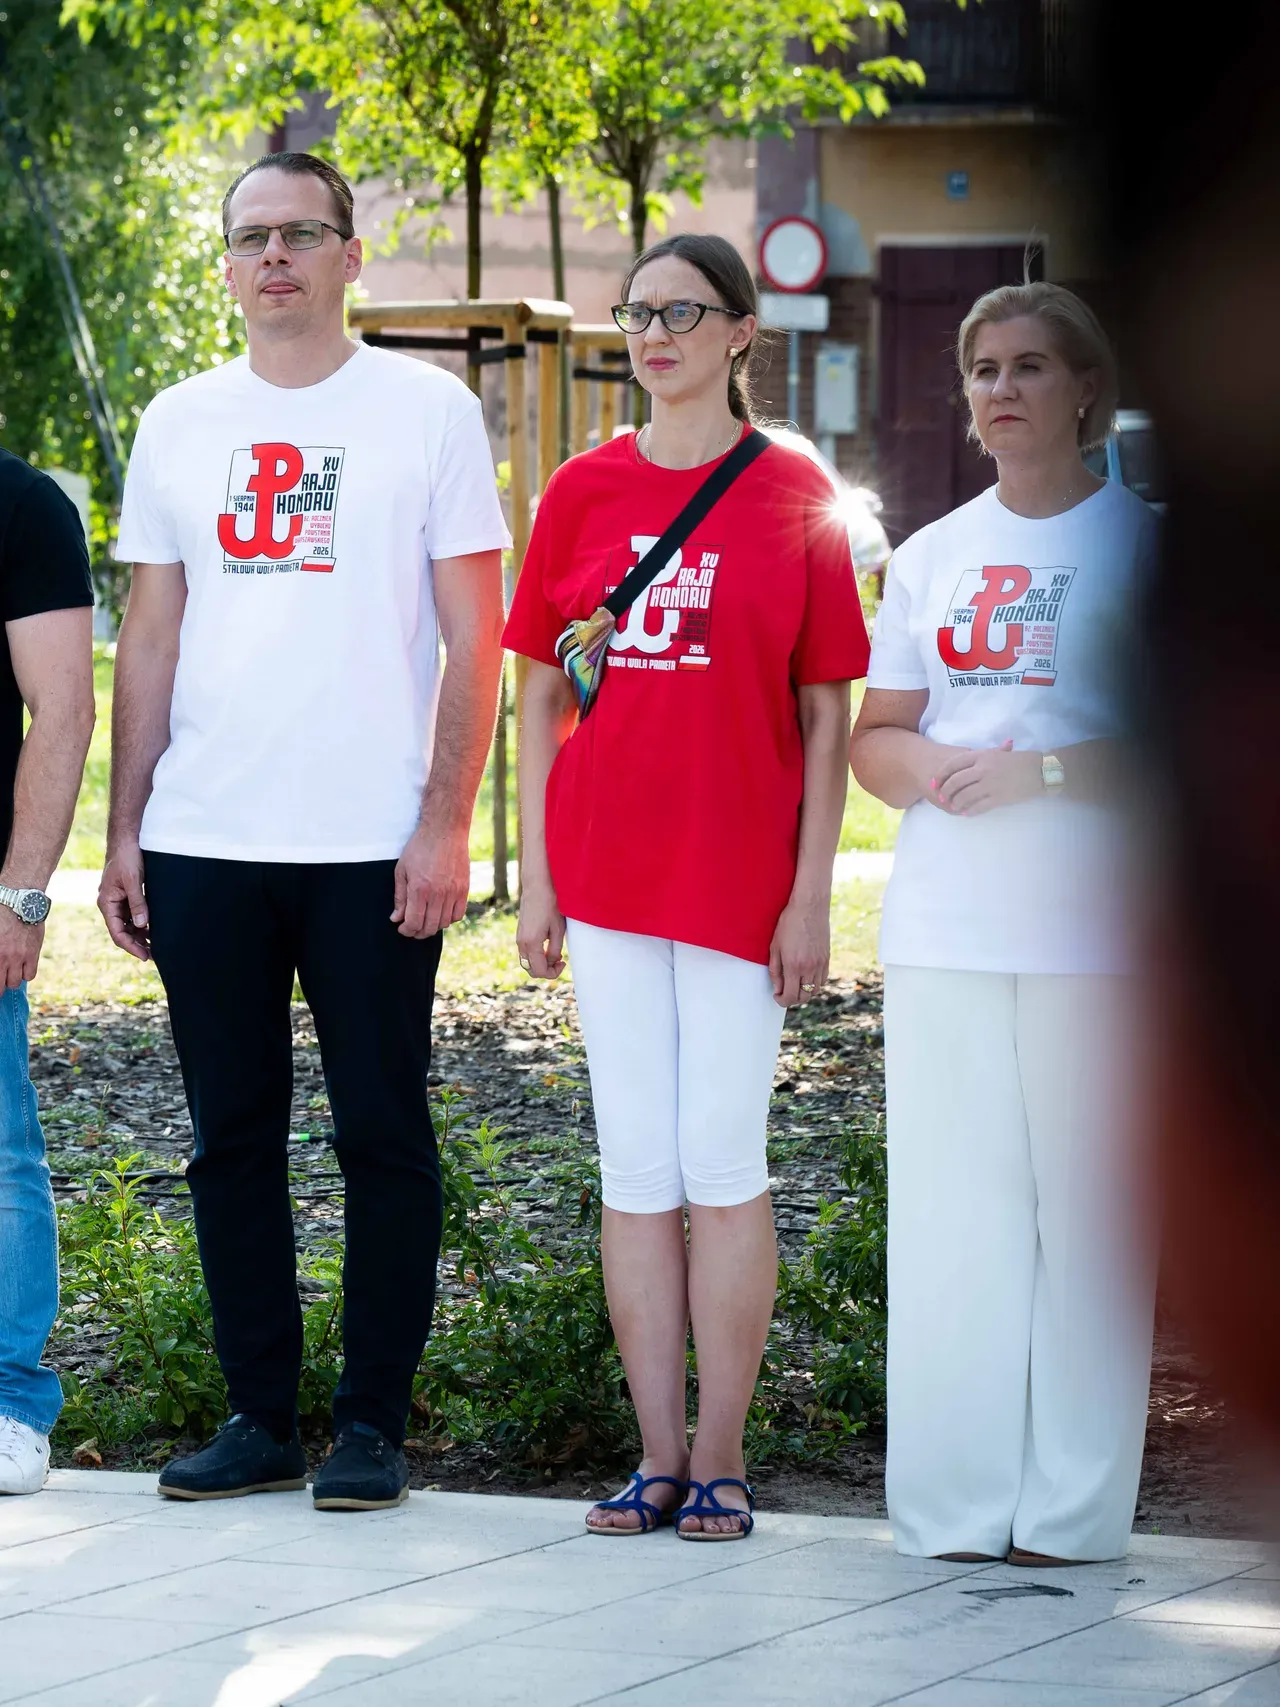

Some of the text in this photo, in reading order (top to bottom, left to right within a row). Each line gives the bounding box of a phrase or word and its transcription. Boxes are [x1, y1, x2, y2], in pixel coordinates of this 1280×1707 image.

[323, 456, 339, 471] XV
[302, 473, 336, 491] RAJD
[235, 502, 254, 512] 1944
[277, 492, 334, 514] HONORU
[313, 546, 328, 555] 2026
[700, 552, 719, 568] XV
[223, 564, 255, 574] STALOWA
[257, 565, 273, 574] WOLA
[677, 568, 715, 587] RAJD
[1051, 574, 1070, 587] XV
[650, 587, 711, 609] HONORU
[1025, 588, 1064, 604] RAJD
[954, 615, 972, 624] 1944
[993, 603, 1059, 623] HONORU
[689, 644, 704, 654] 2026
[627, 658, 648, 668] WOLA
[1034, 659, 1051, 668] 2026
[949, 676, 979, 687] STALOWA
[980, 676, 998, 686] WOLA
